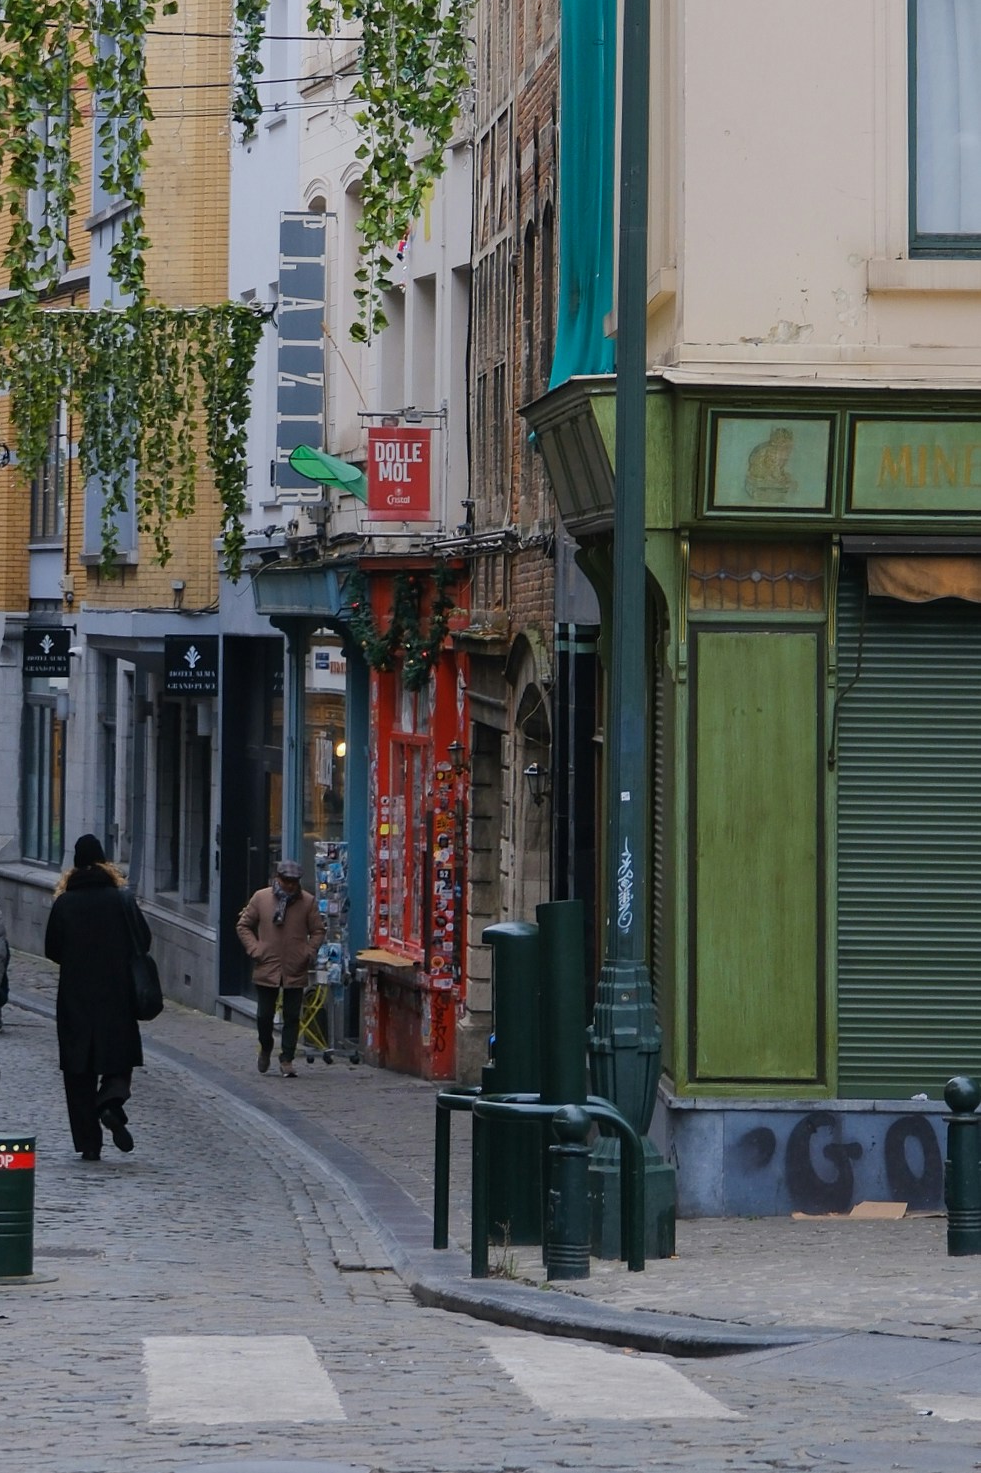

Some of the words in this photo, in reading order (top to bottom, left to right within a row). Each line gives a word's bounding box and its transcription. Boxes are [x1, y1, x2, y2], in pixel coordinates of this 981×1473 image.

[375, 442, 423, 463] DOLLE
[379, 461, 412, 482] MOL
[387, 494, 410, 505] Cristal
